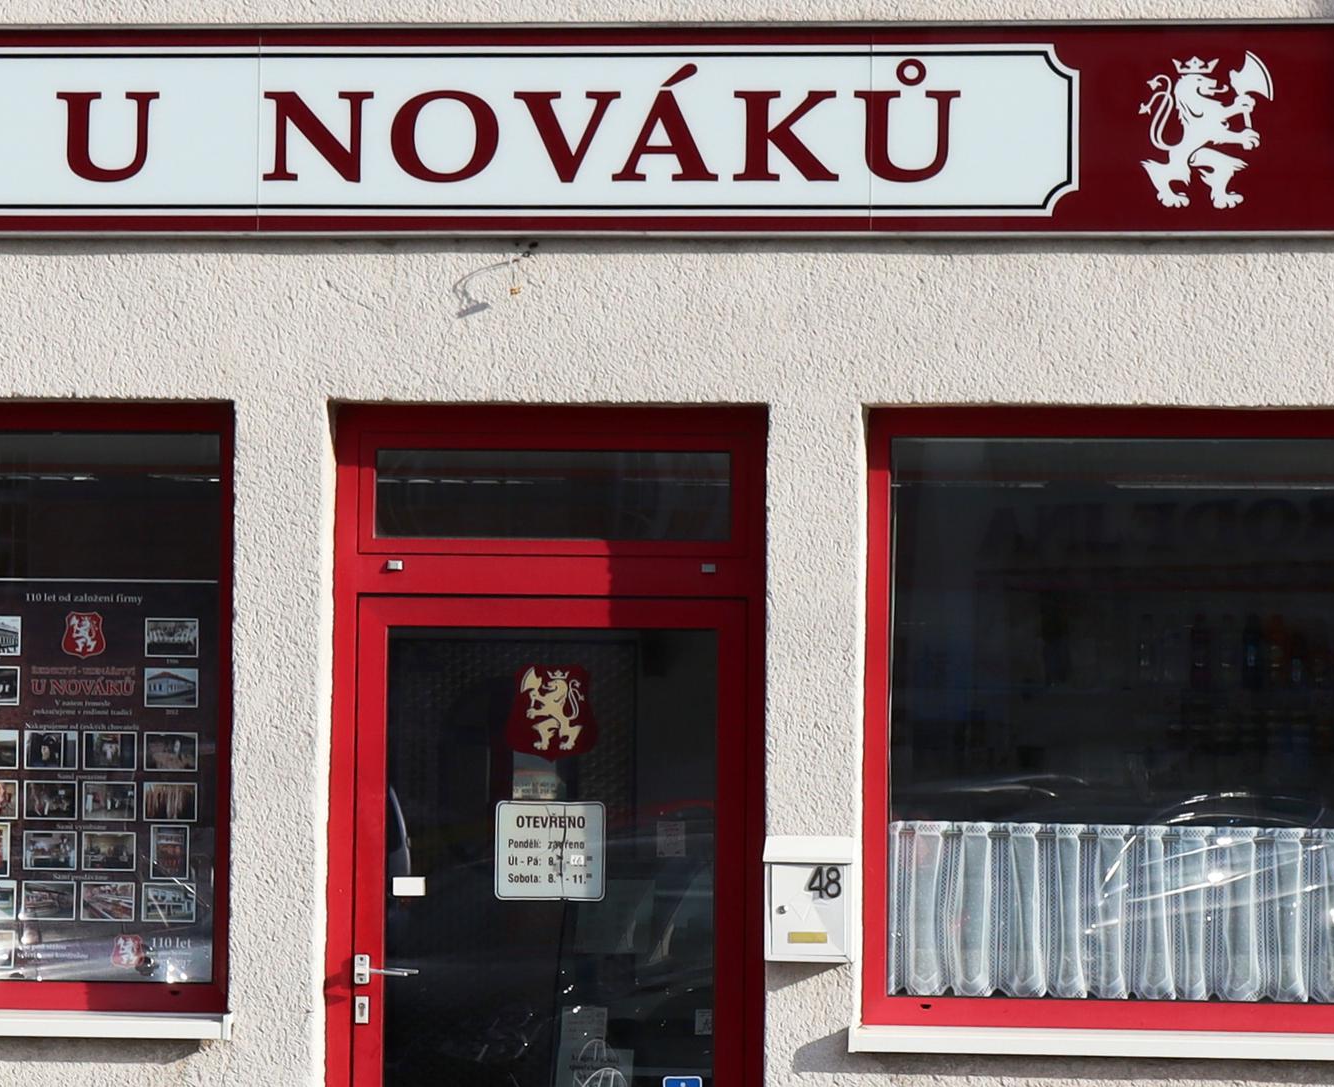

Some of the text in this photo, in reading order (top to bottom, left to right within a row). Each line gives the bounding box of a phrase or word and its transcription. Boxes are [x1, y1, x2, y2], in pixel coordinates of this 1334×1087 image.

[56, 58, 961, 184] U NOVÁKŮ
[44, 592, 57, 602] let
[59, 592, 72, 602] od
[116, 592, 143, 606] firmy
[30, 676, 136, 697] U NOVÁKŮ
[516, 812, 586, 829] OTEVŘENO
[508, 838, 542, 849] Pondělí:
[508, 872, 542, 884] Sobota:
[807, 865, 842, 899] 48
[152, 936, 192, 949] 110 let
